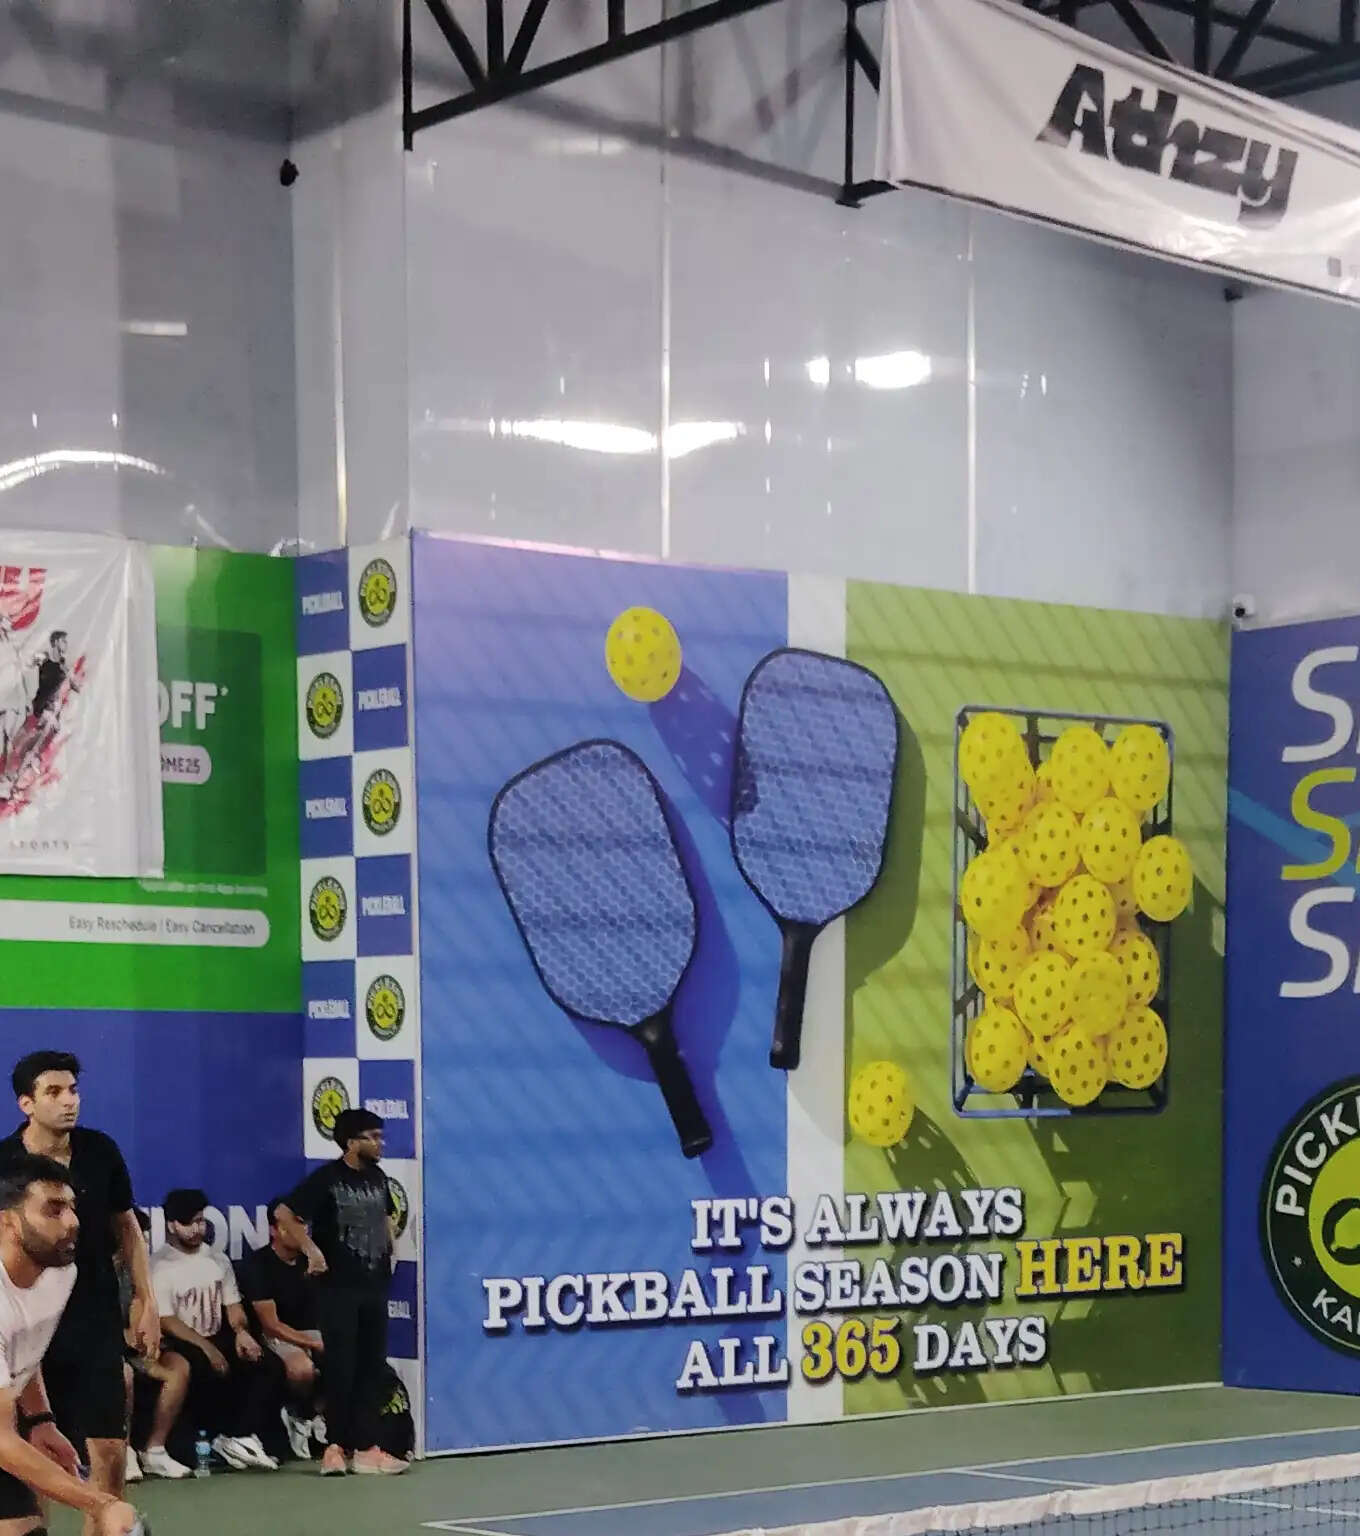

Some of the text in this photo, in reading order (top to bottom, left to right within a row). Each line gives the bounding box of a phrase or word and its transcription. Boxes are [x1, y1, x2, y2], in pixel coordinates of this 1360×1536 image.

[691, 1186, 1025, 1250] IT'S ALWAYS
[482, 1231, 1185, 1329] PICKBALL SEASON HERE
[676, 1316, 1048, 1391] ALL 365 DAYS
